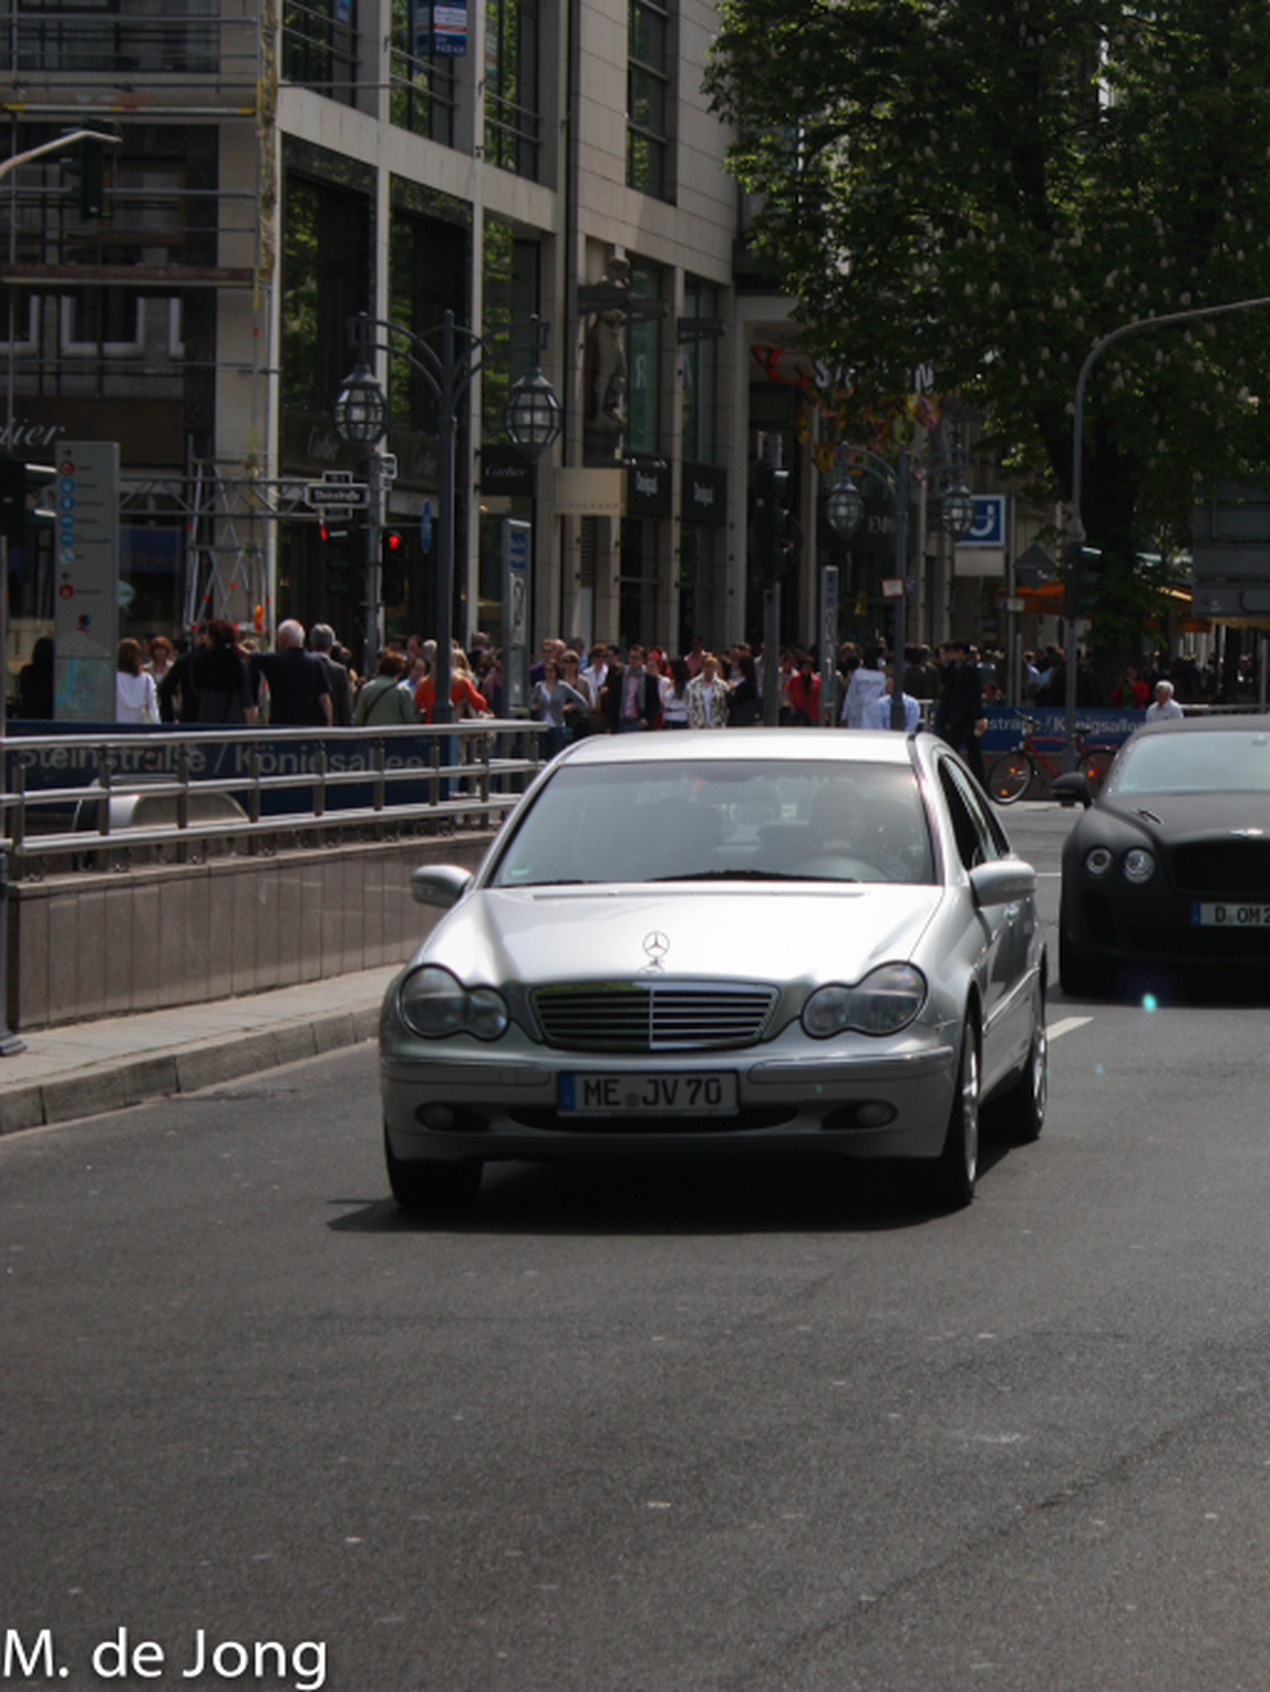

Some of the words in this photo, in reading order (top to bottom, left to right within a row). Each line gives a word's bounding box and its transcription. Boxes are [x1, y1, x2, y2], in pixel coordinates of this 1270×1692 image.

[0, 418, 66, 446] tier
[234, 744, 424, 774] Königsalee
[1215, 906, 1226, 923] D
[584, 1079, 621, 1106] ME
[642, 1079, 678, 1105] JV
[686, 1078, 722, 1105] 70
